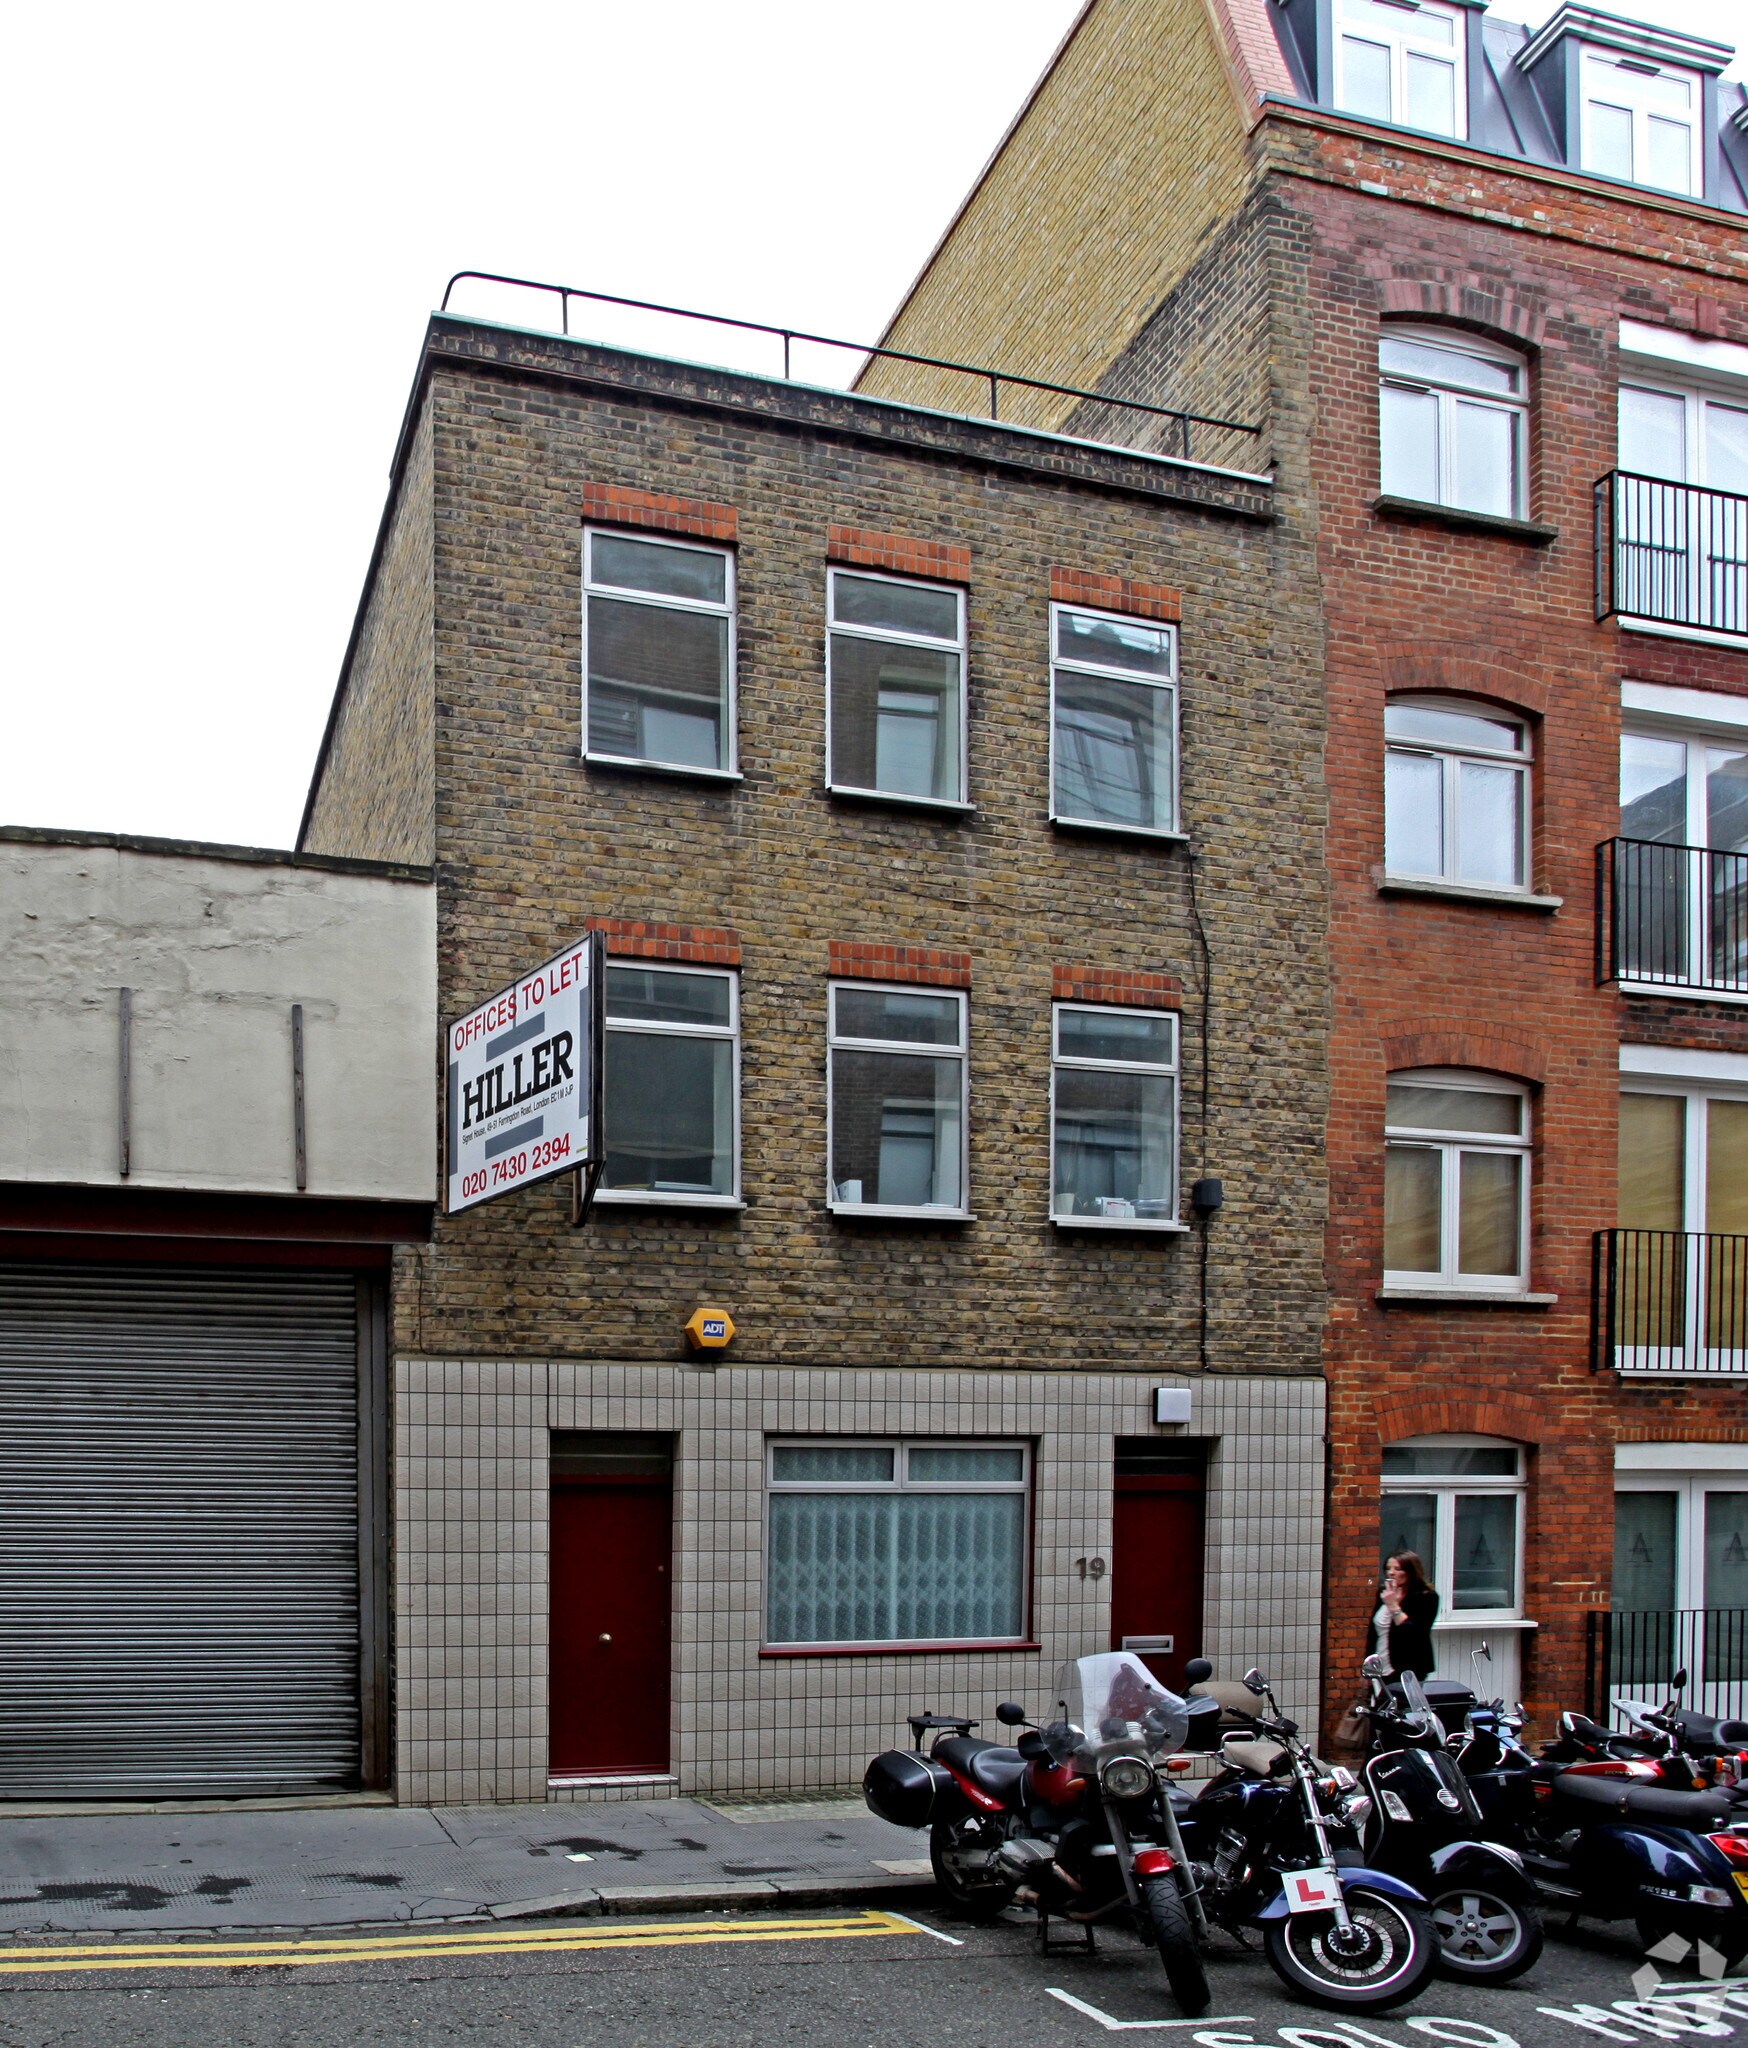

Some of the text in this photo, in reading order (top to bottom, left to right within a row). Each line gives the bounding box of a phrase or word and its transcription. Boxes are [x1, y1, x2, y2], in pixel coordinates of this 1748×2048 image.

[454, 952, 582, 1051] OFFICES TO LET
[462, 1030, 574, 1130] HILLER
[533, 1096, 550, 1111] London
[462, 1132, 570, 1198] 020 7430 2394
[703, 1323, 725, 1334] ADT
[1076, 1557, 1105, 1580] 19
[1295, 1879, 1326, 1902] L
